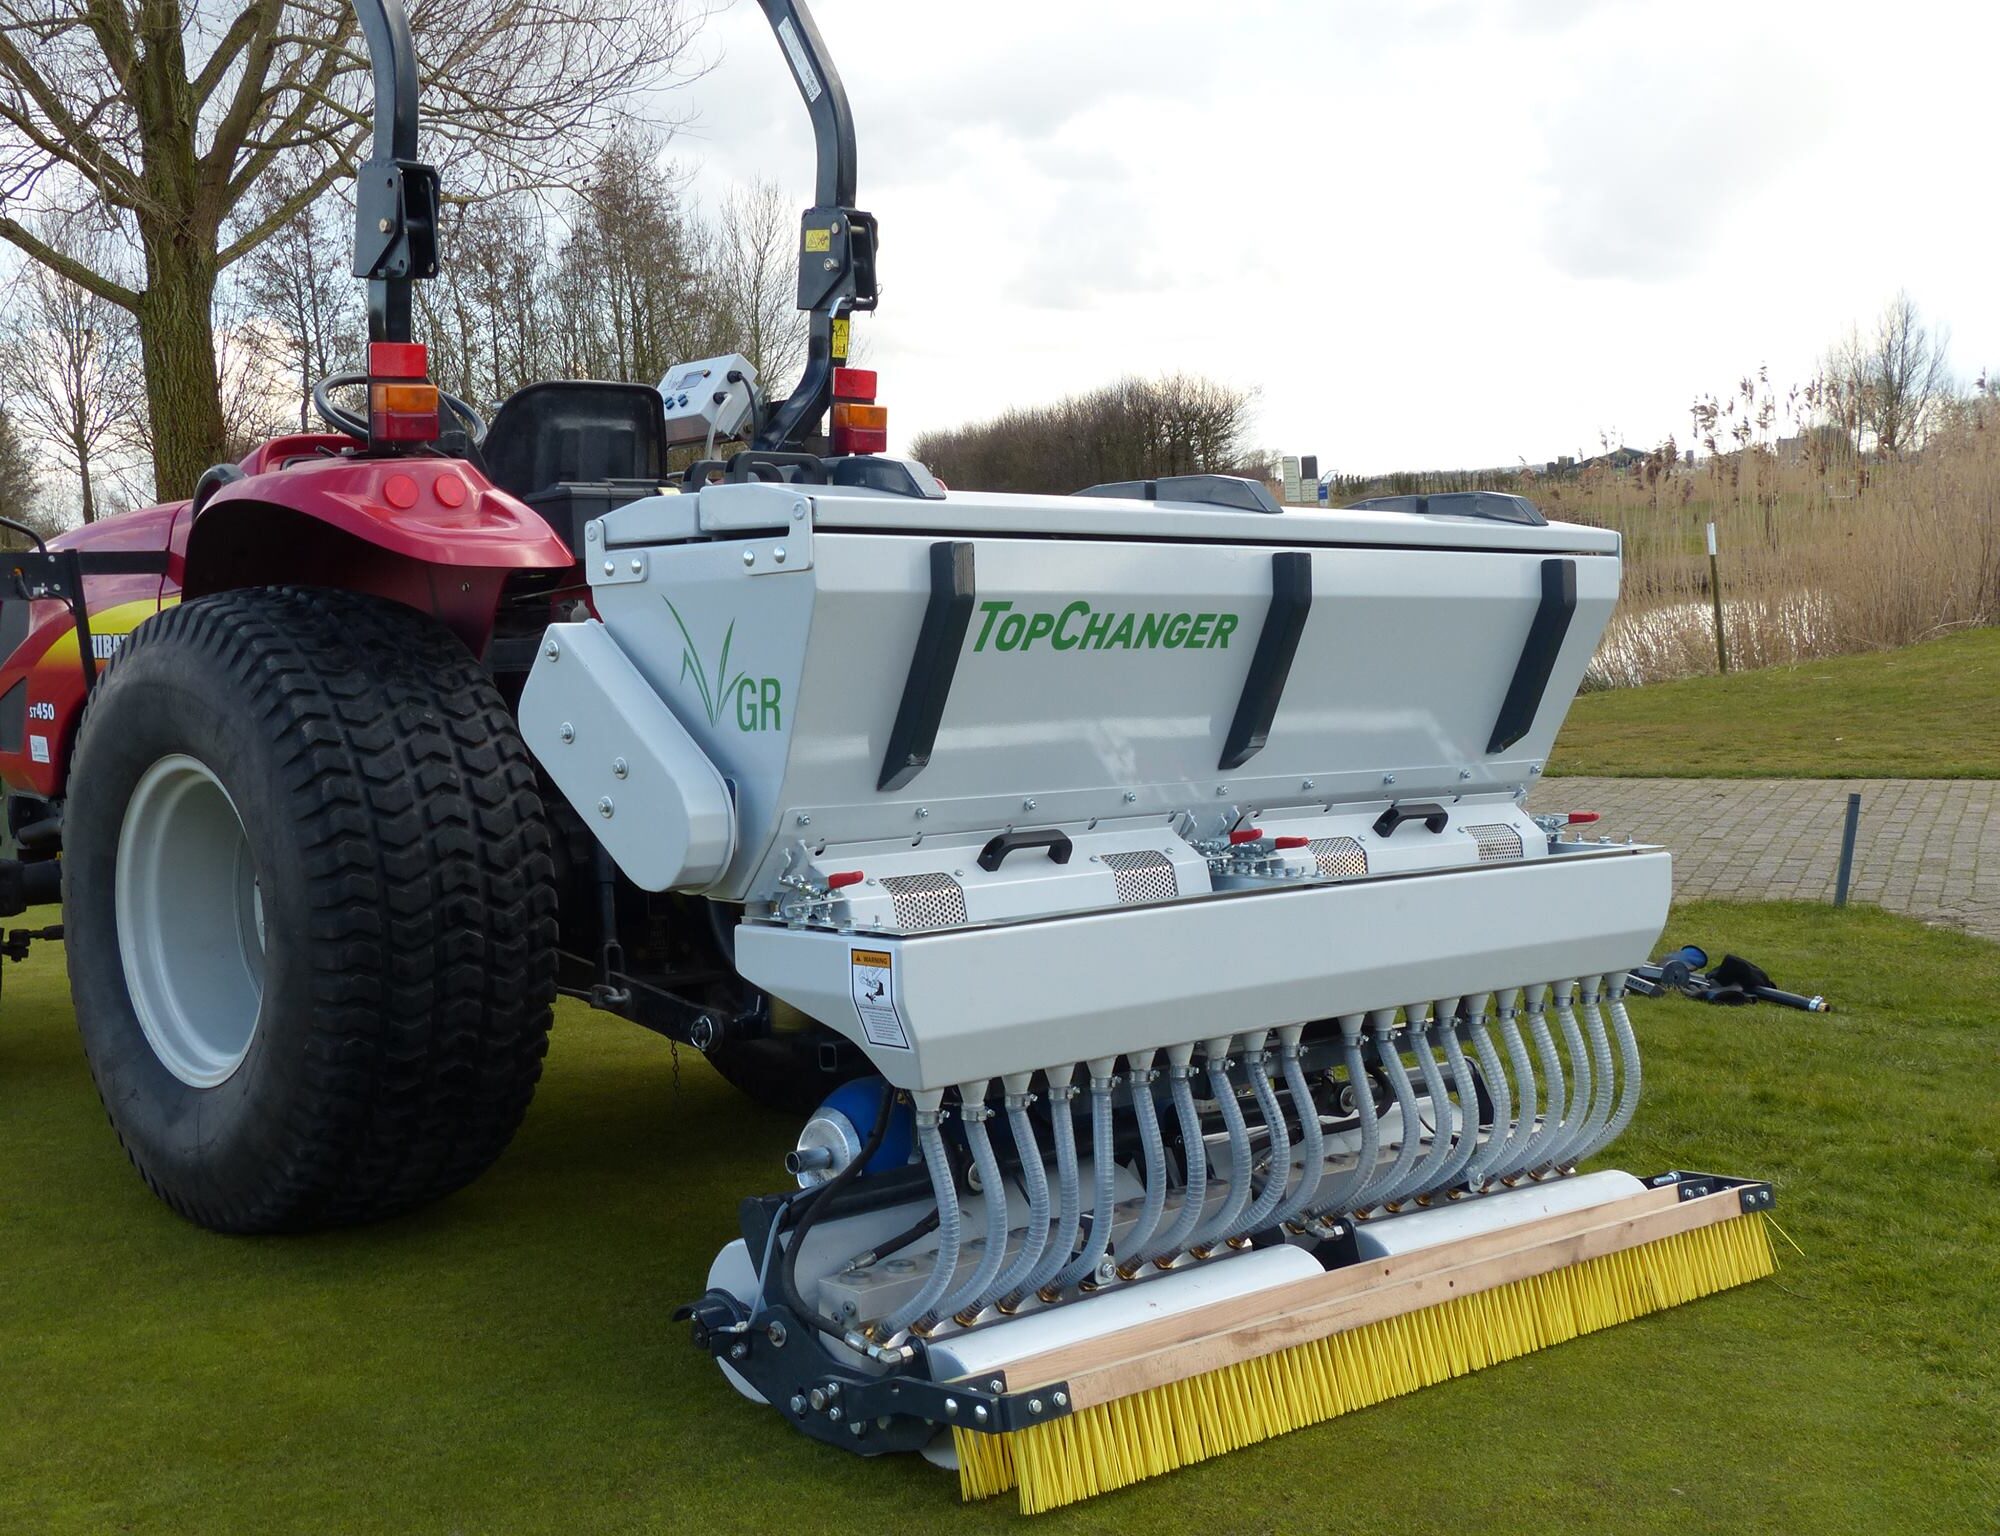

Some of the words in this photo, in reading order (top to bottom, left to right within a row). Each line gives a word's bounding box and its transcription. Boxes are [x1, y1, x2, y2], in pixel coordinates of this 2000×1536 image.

[973, 600, 1239, 652] TOPCHANGER
[29, 702, 55, 720] ST450
[736, 677, 782, 732] GR
[863, 956, 888, 965] WARNING
